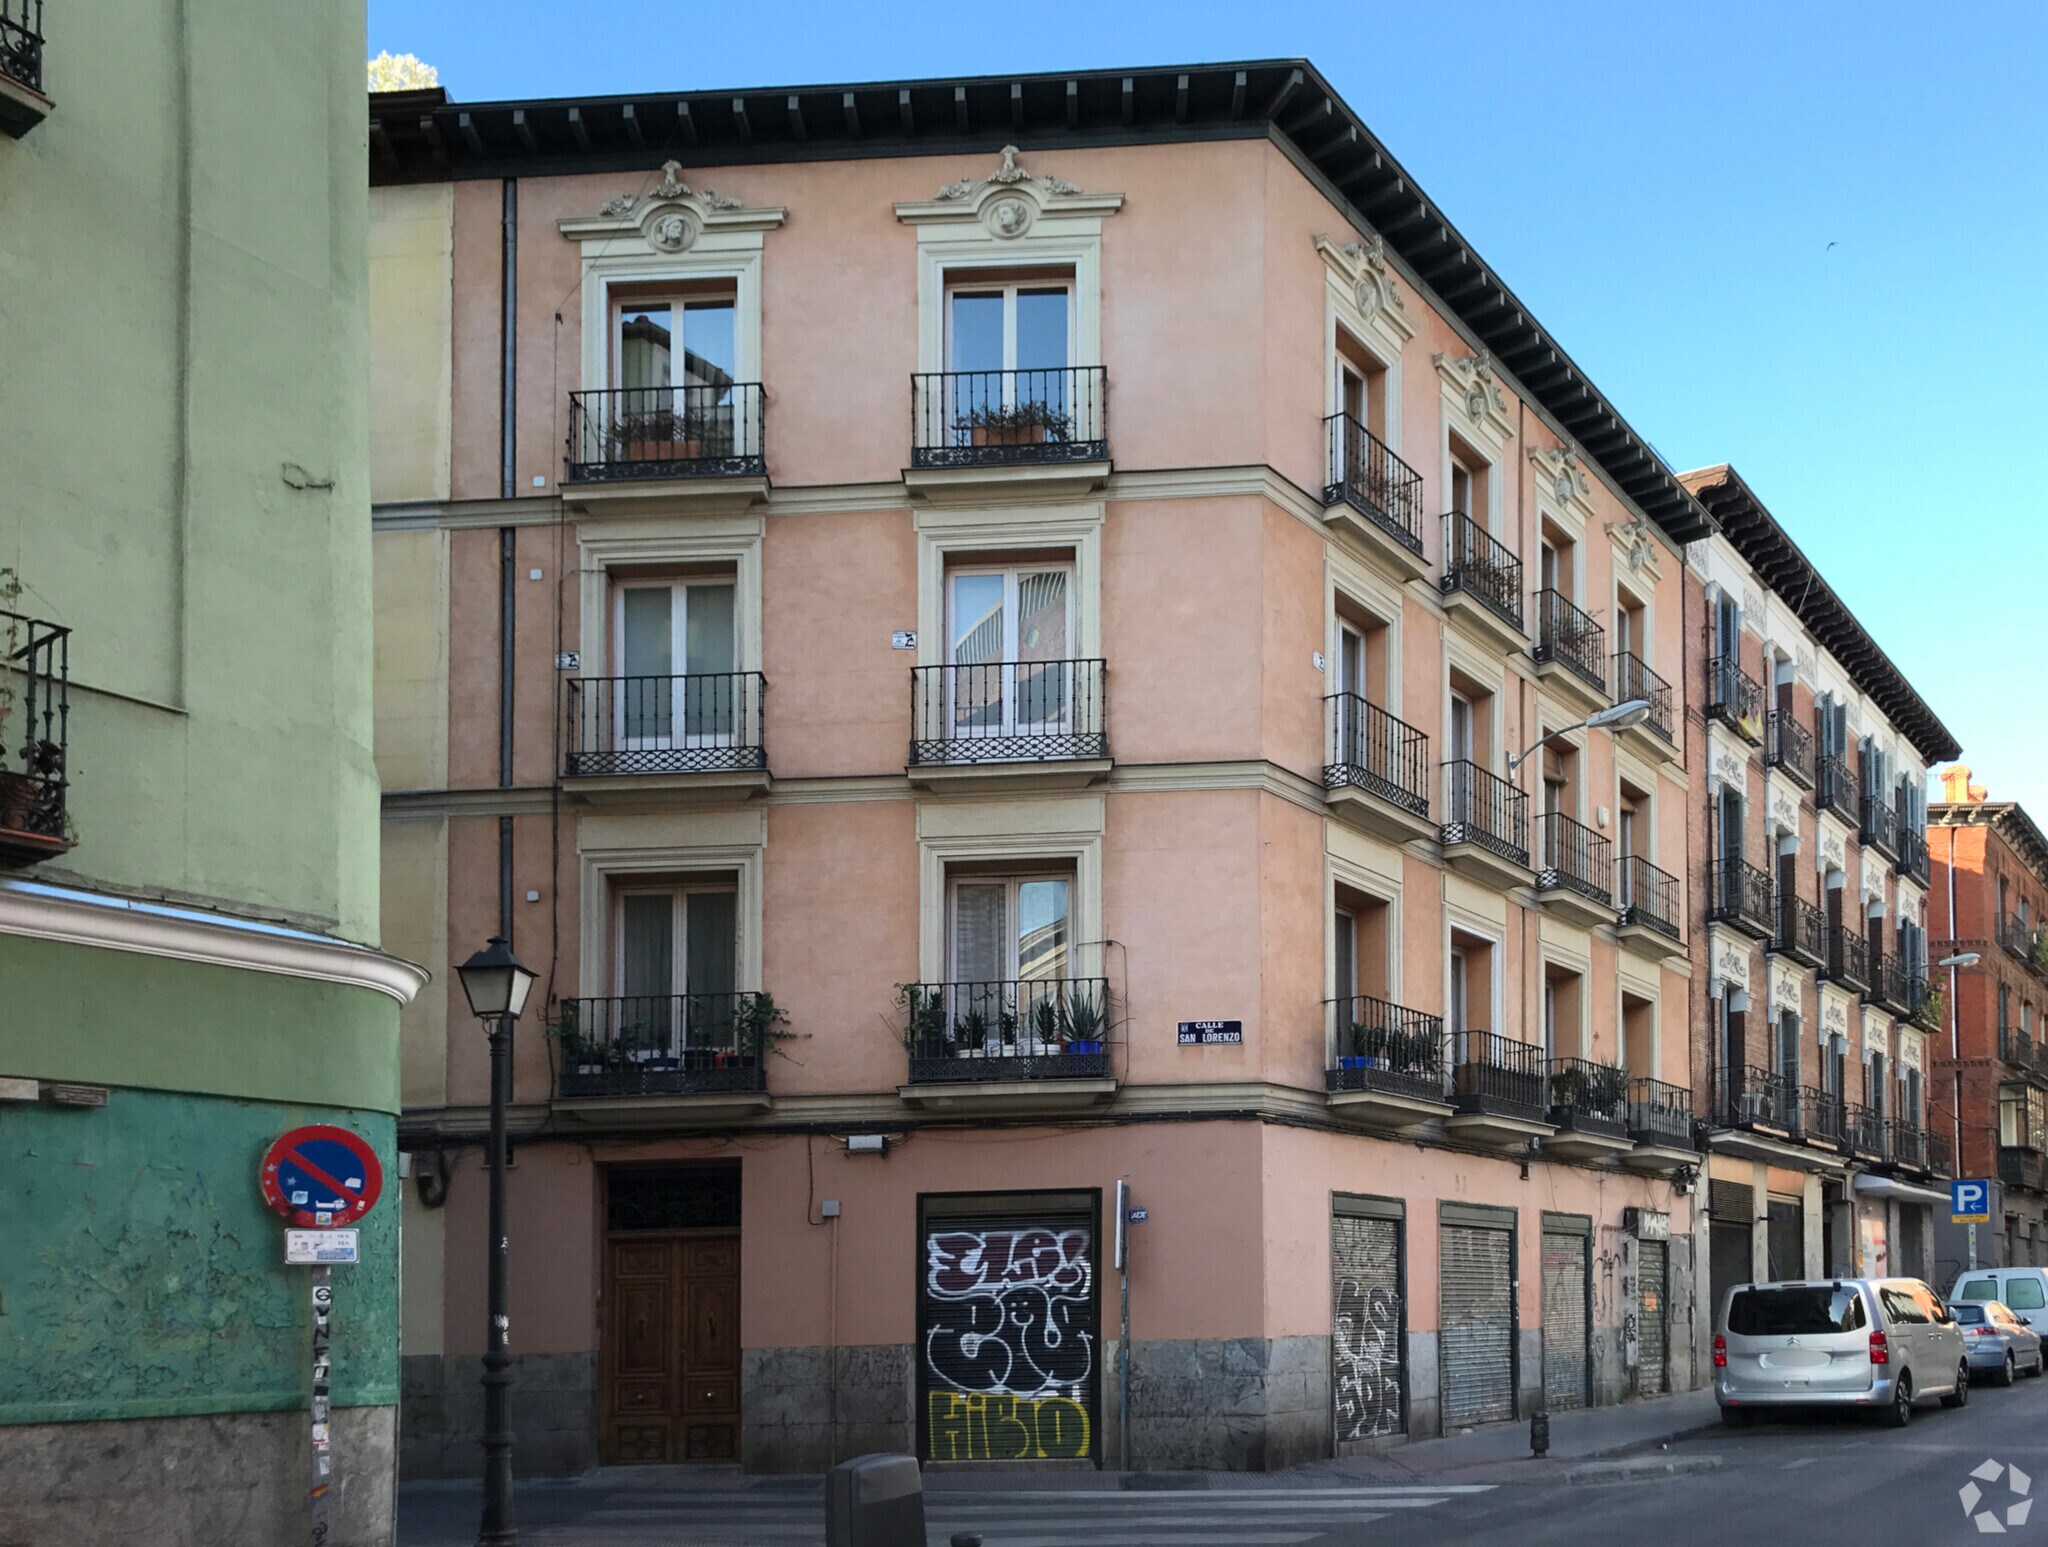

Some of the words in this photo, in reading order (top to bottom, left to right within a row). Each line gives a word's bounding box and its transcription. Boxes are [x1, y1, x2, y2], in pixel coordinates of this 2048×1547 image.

[1180, 1033, 1196, 1043] SAN
[1202, 1032, 1240, 1043] LORENZO
[1957, 1184, 1982, 1211] P
[1131, 1211, 1147, 1219] ADT
